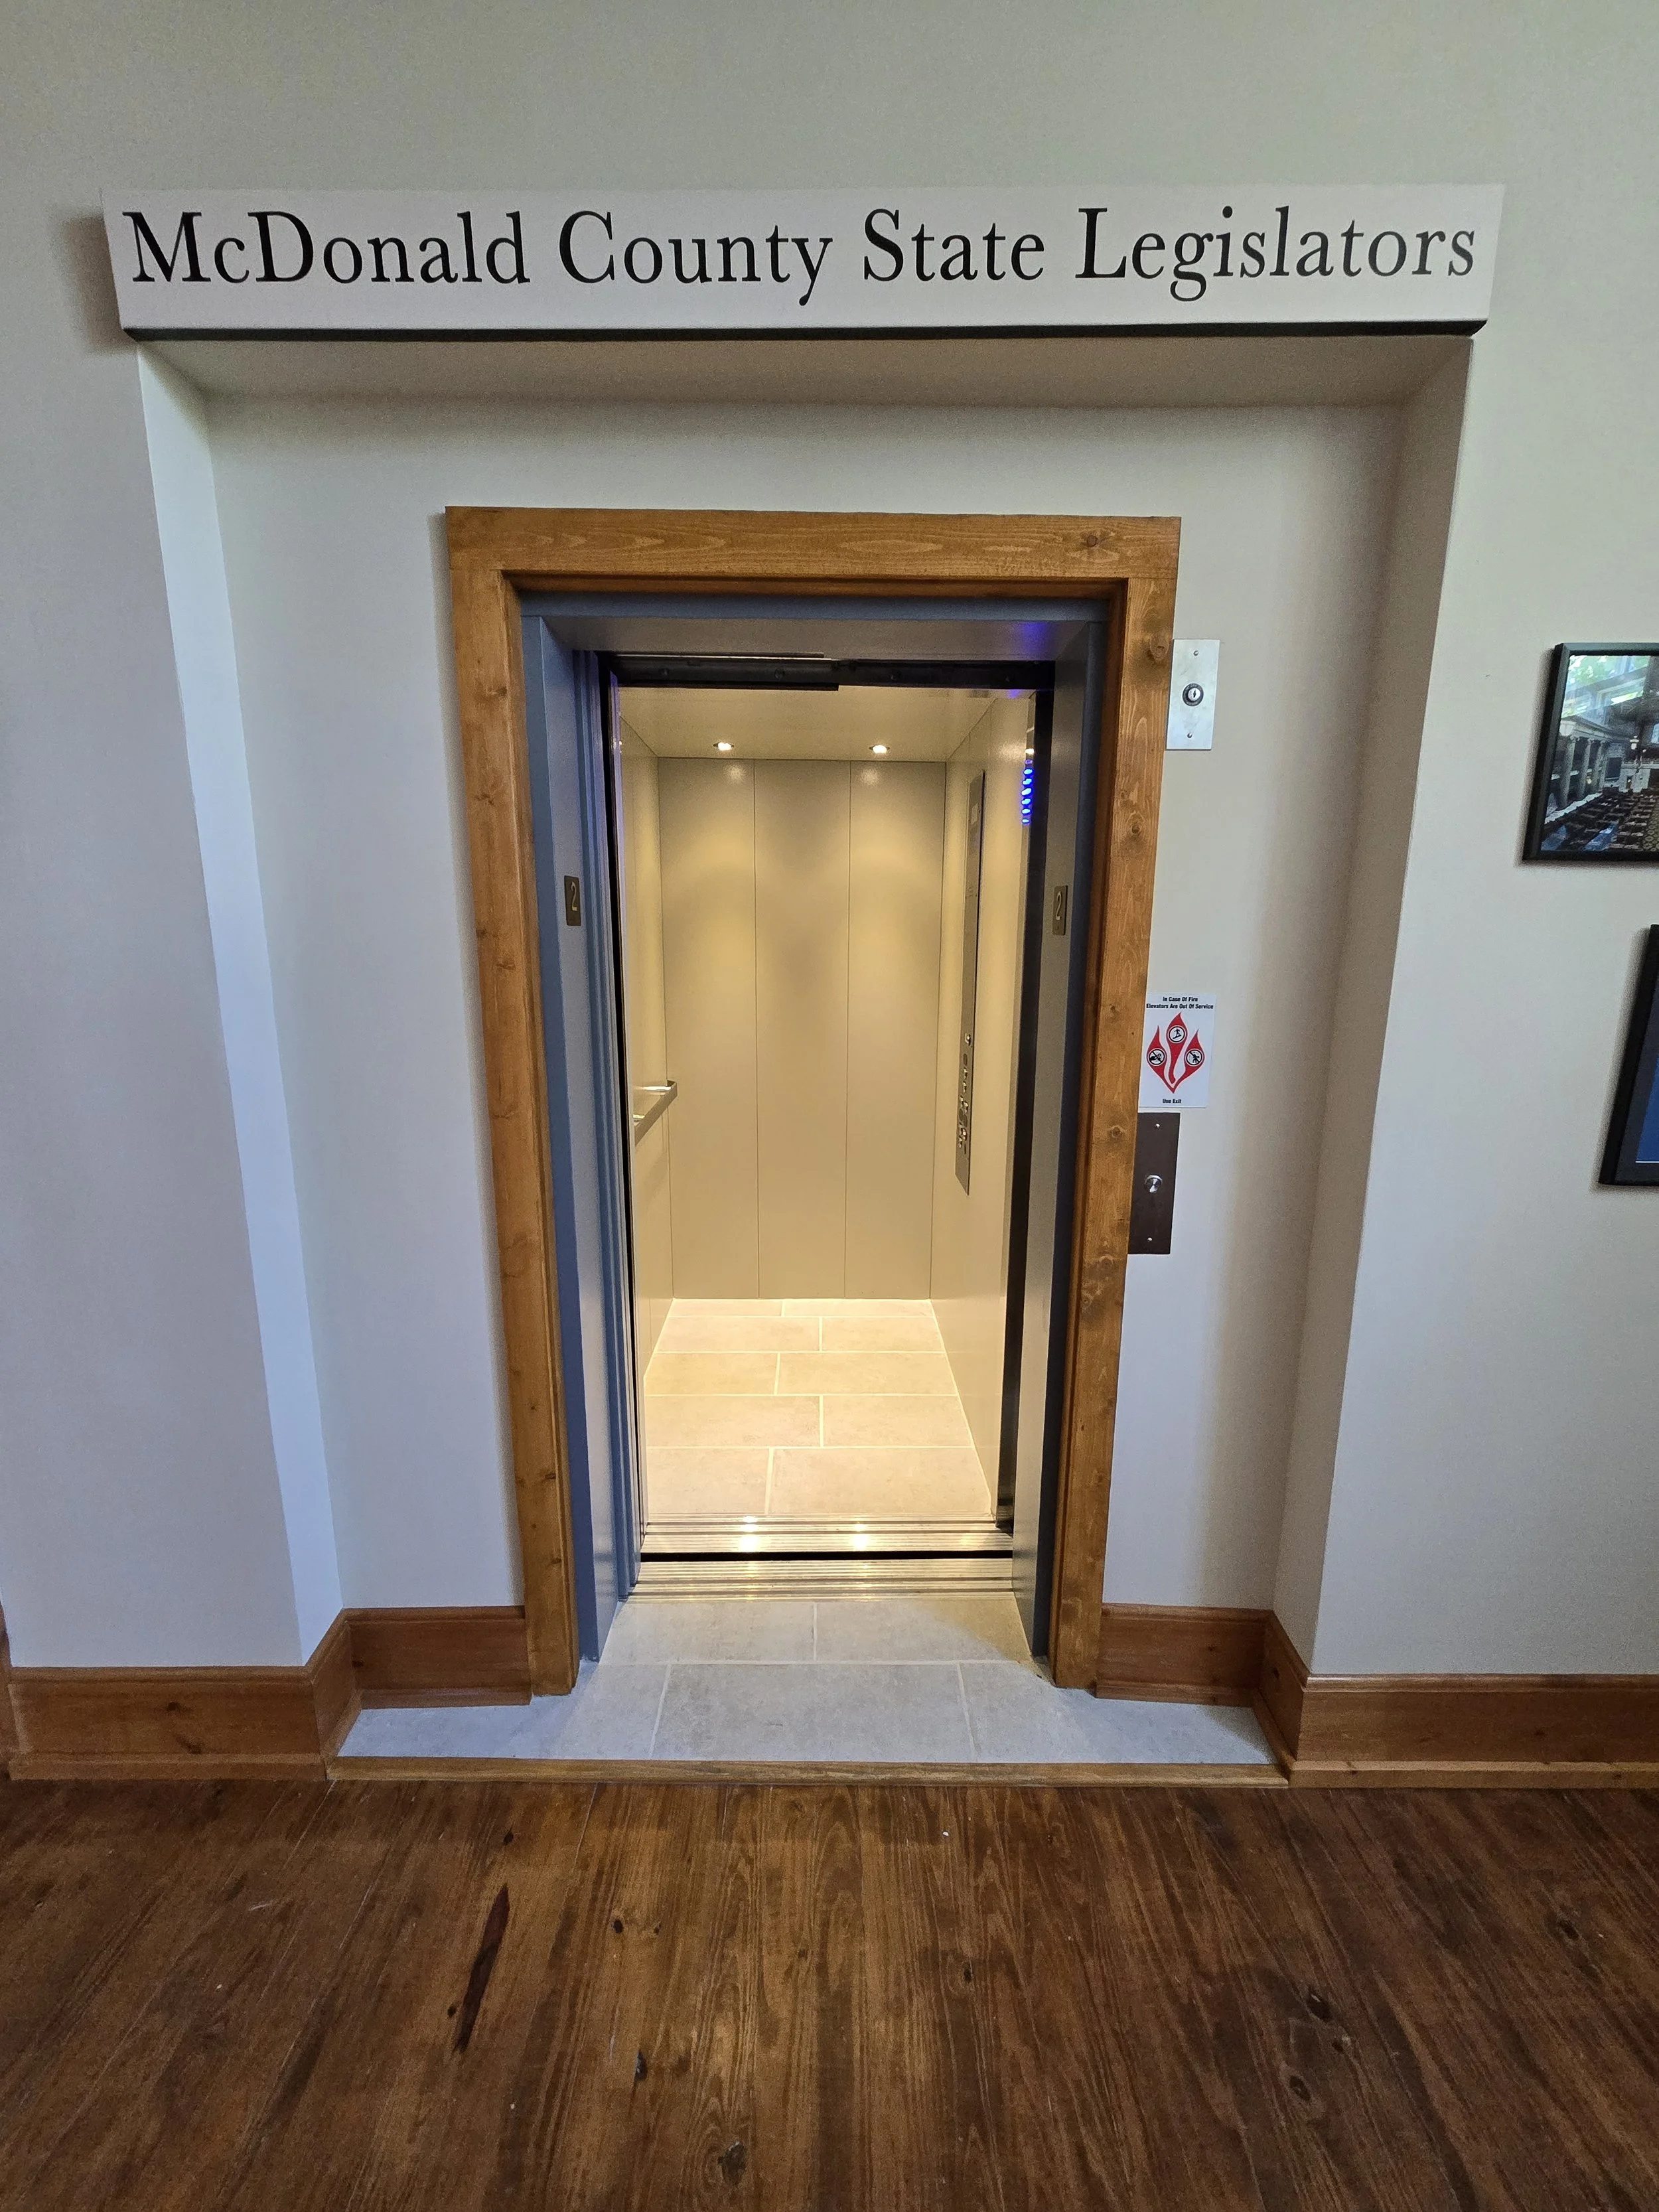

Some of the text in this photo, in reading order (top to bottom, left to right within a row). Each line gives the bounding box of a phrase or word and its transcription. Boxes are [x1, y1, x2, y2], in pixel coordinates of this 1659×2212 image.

[122, 206, 1475, 306] McDonald County State Legislators
[571, 881, 577, 911] 2
[1056, 891, 1061, 920] 2
